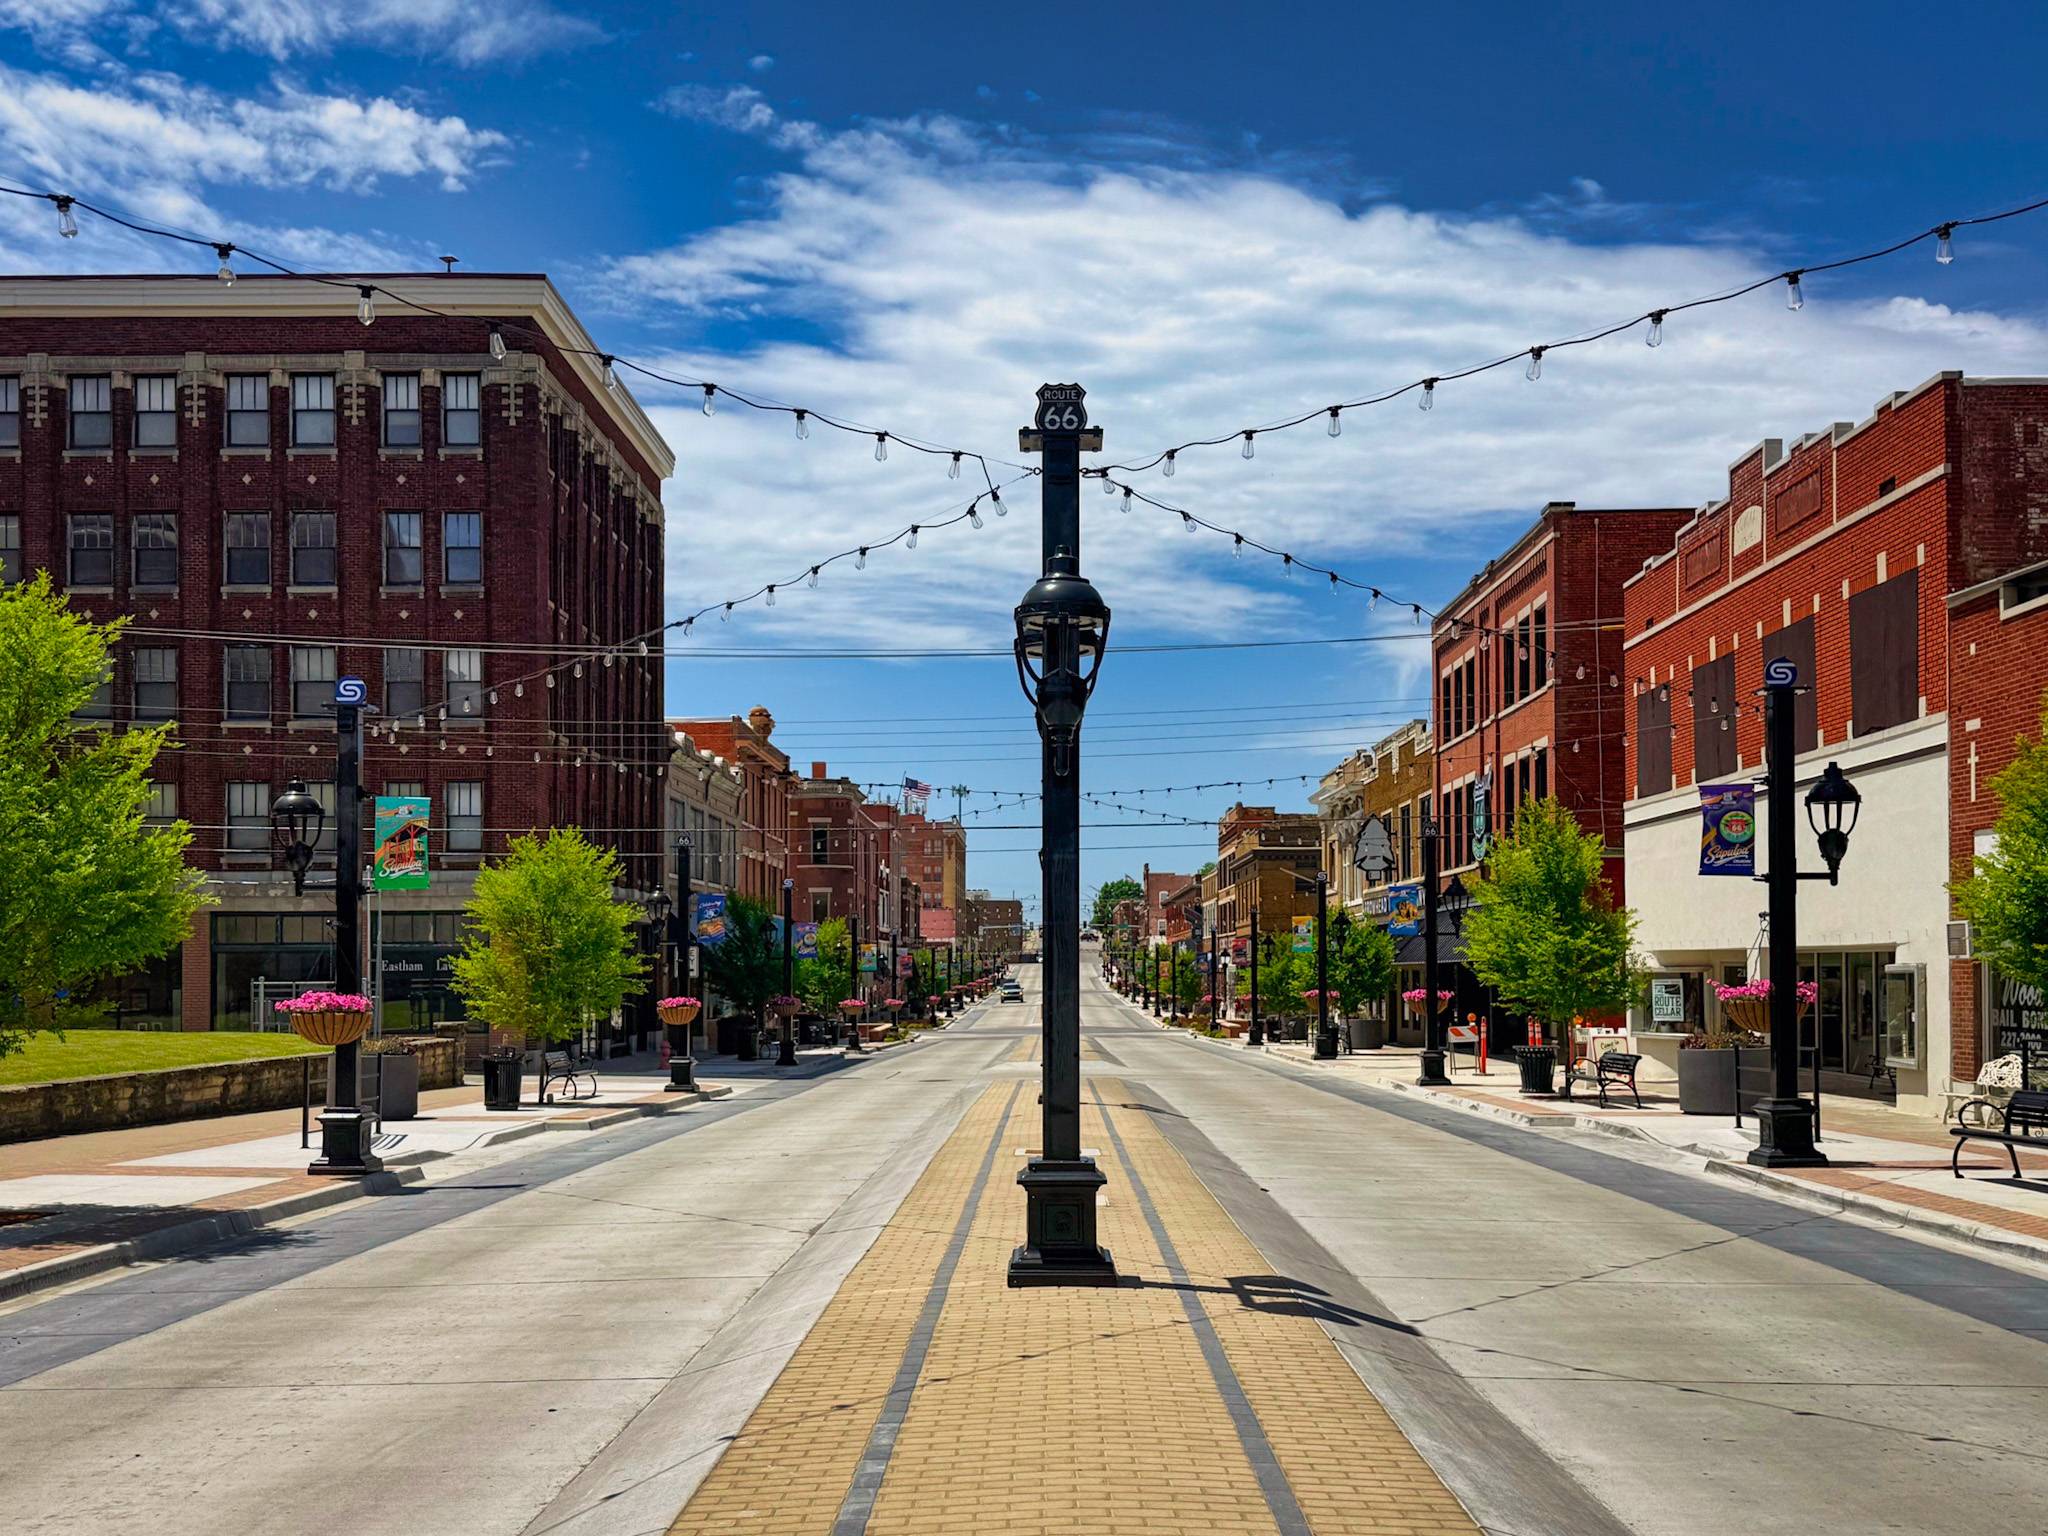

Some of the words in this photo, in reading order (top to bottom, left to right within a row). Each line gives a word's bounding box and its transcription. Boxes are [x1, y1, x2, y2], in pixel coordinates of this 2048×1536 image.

[1044, 390, 1078, 400] ROUTE
[1044, 406, 1079, 430] 66
[1425, 828, 1436, 836] 66
[678, 836, 690, 846] 66
[1703, 844, 1750, 865] Sapulpa
[382, 960, 423, 972] Eastham
[1655, 996, 1682, 1007] ROUTE
[1655, 1007, 1682, 1017] CELLAR
[1992, 1008, 2018, 1028] BAIL
